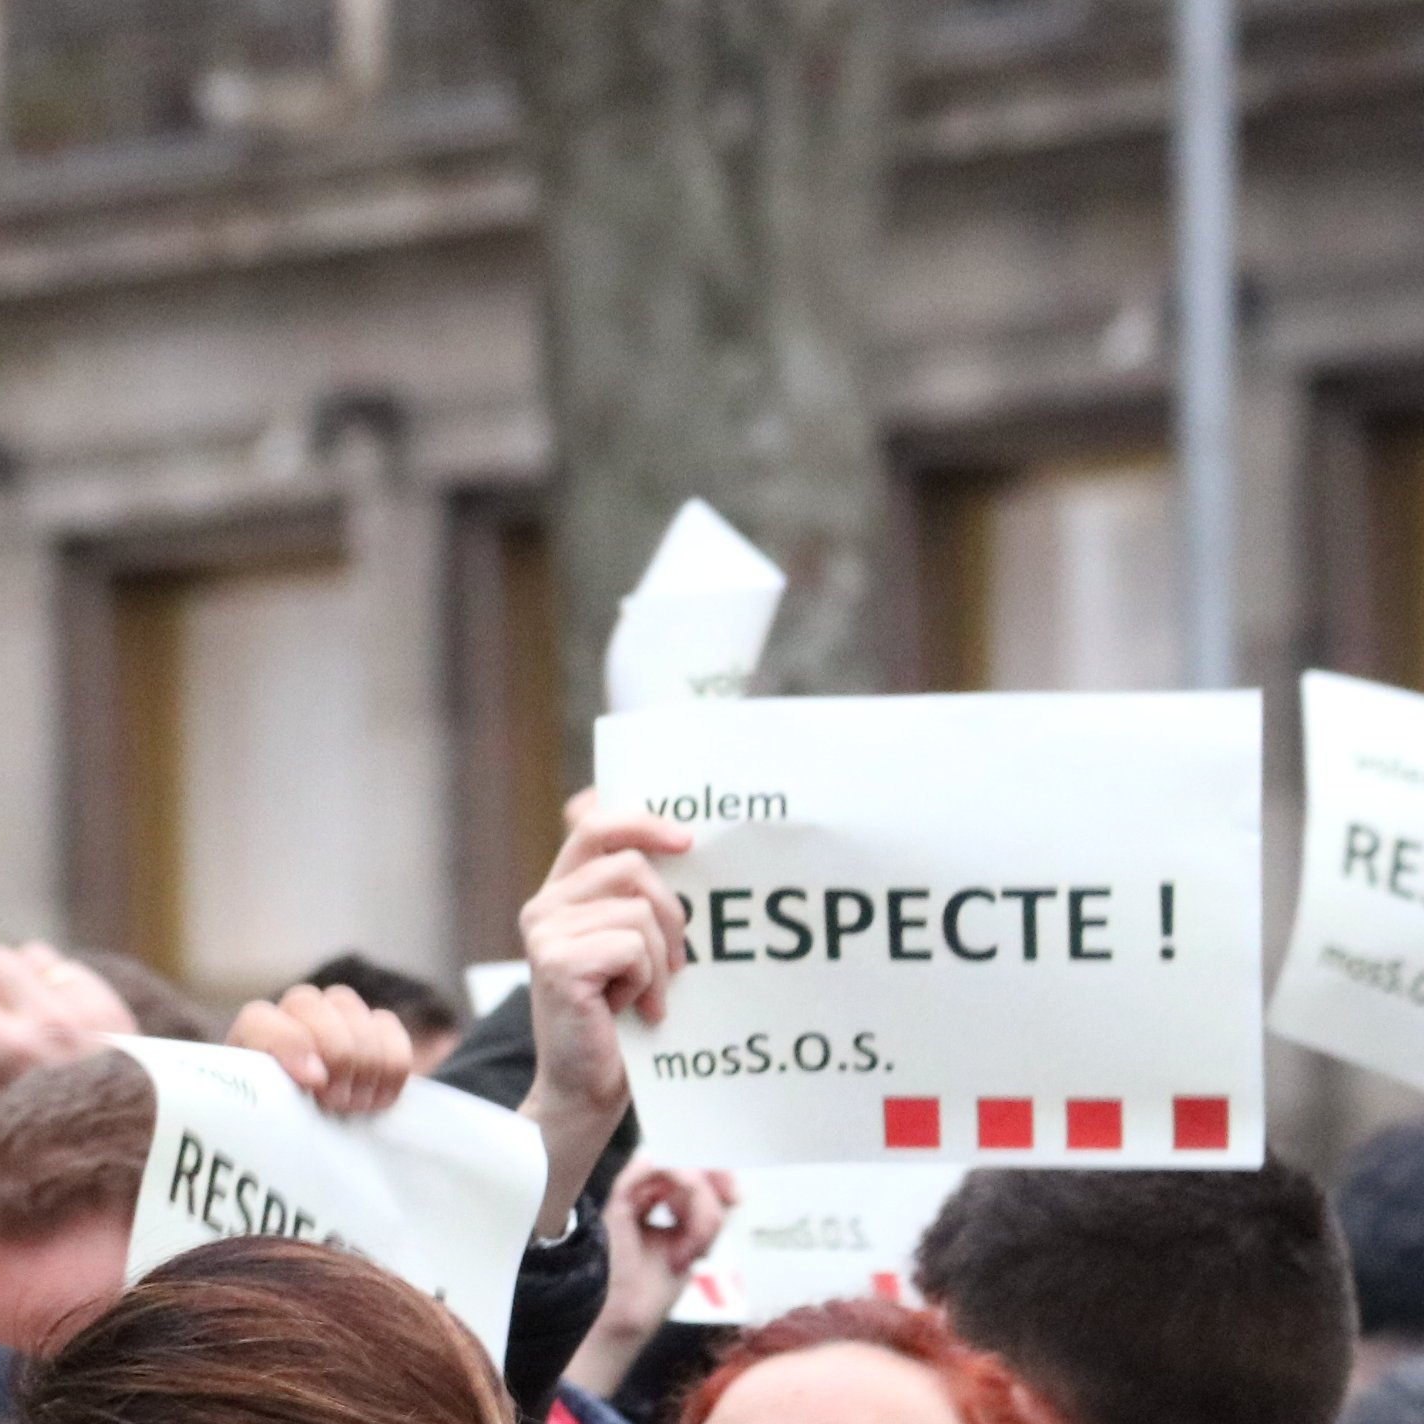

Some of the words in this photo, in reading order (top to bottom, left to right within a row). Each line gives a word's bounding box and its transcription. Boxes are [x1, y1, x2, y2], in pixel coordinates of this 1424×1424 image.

[645, 784, 789, 823] volem
[1158, 883, 1176, 961] !
[652, 1032, 895, 1080] mosS.O.S.
